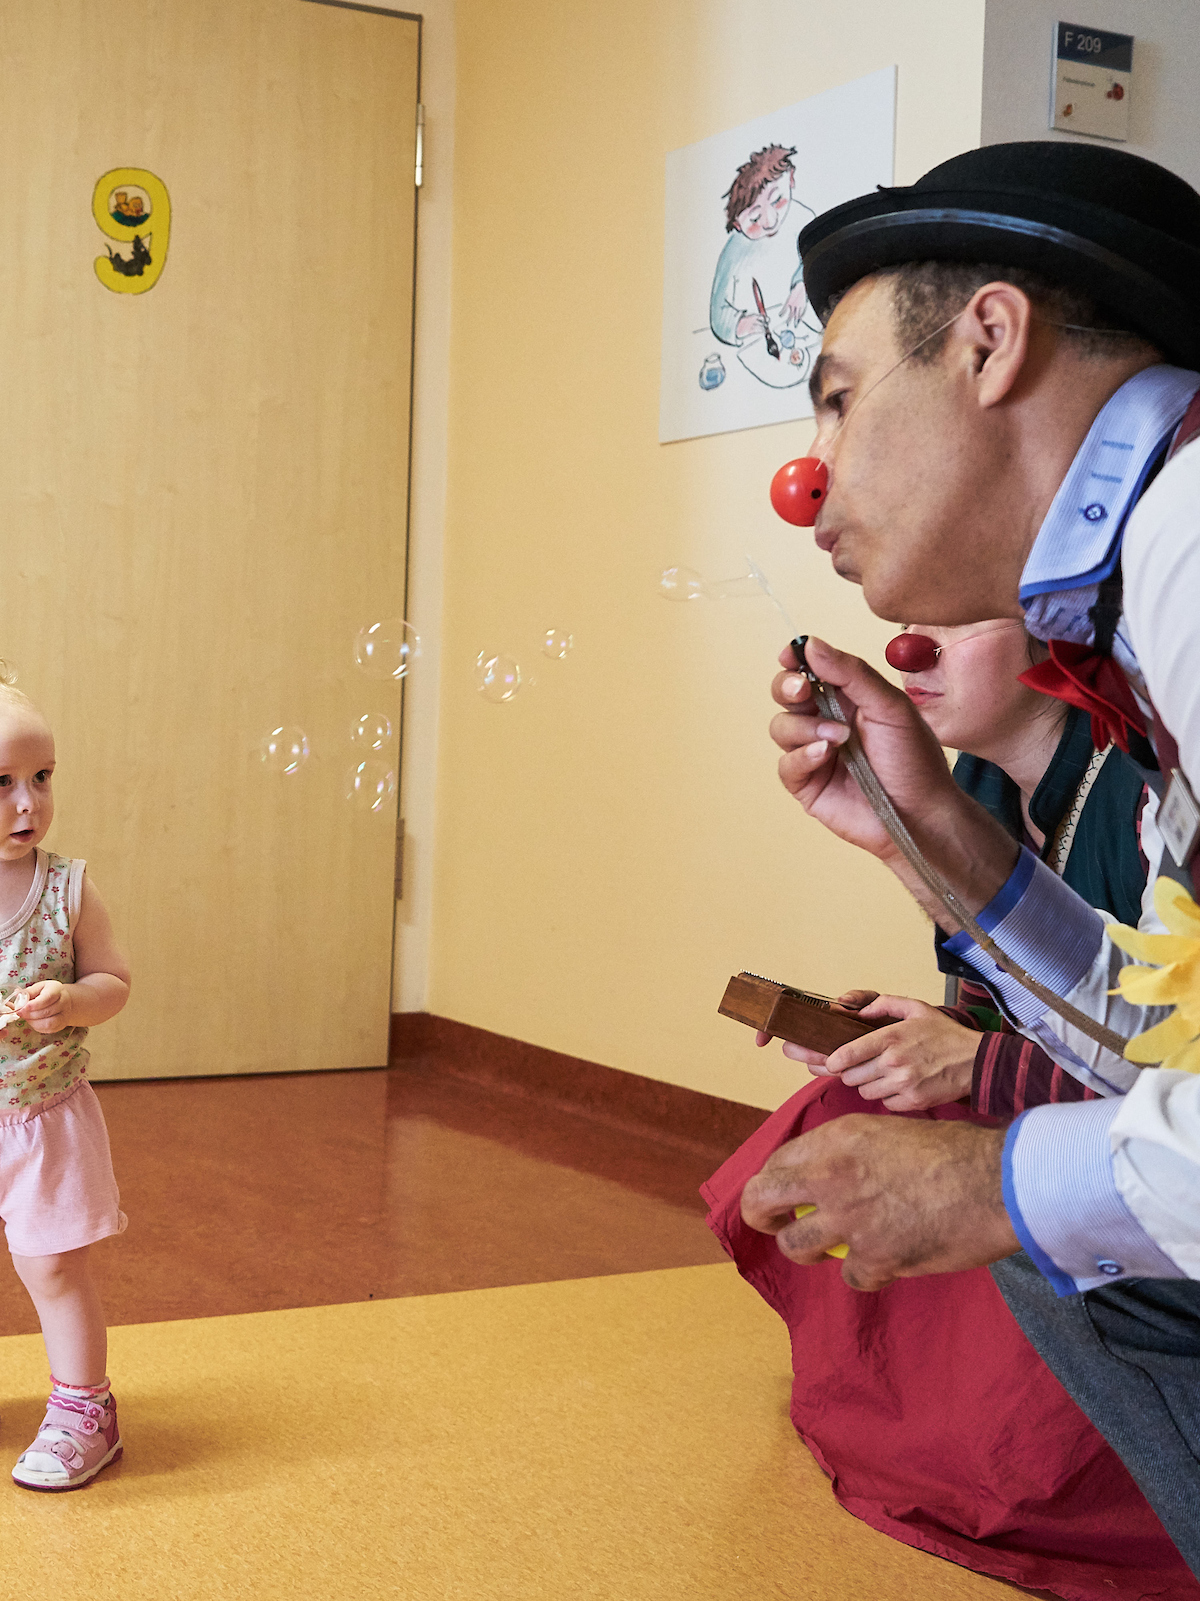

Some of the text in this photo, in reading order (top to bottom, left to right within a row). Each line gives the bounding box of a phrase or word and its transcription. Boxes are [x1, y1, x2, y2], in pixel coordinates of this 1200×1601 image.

[1064, 31, 1102, 53] F 209
[92, 167, 171, 295] 9
